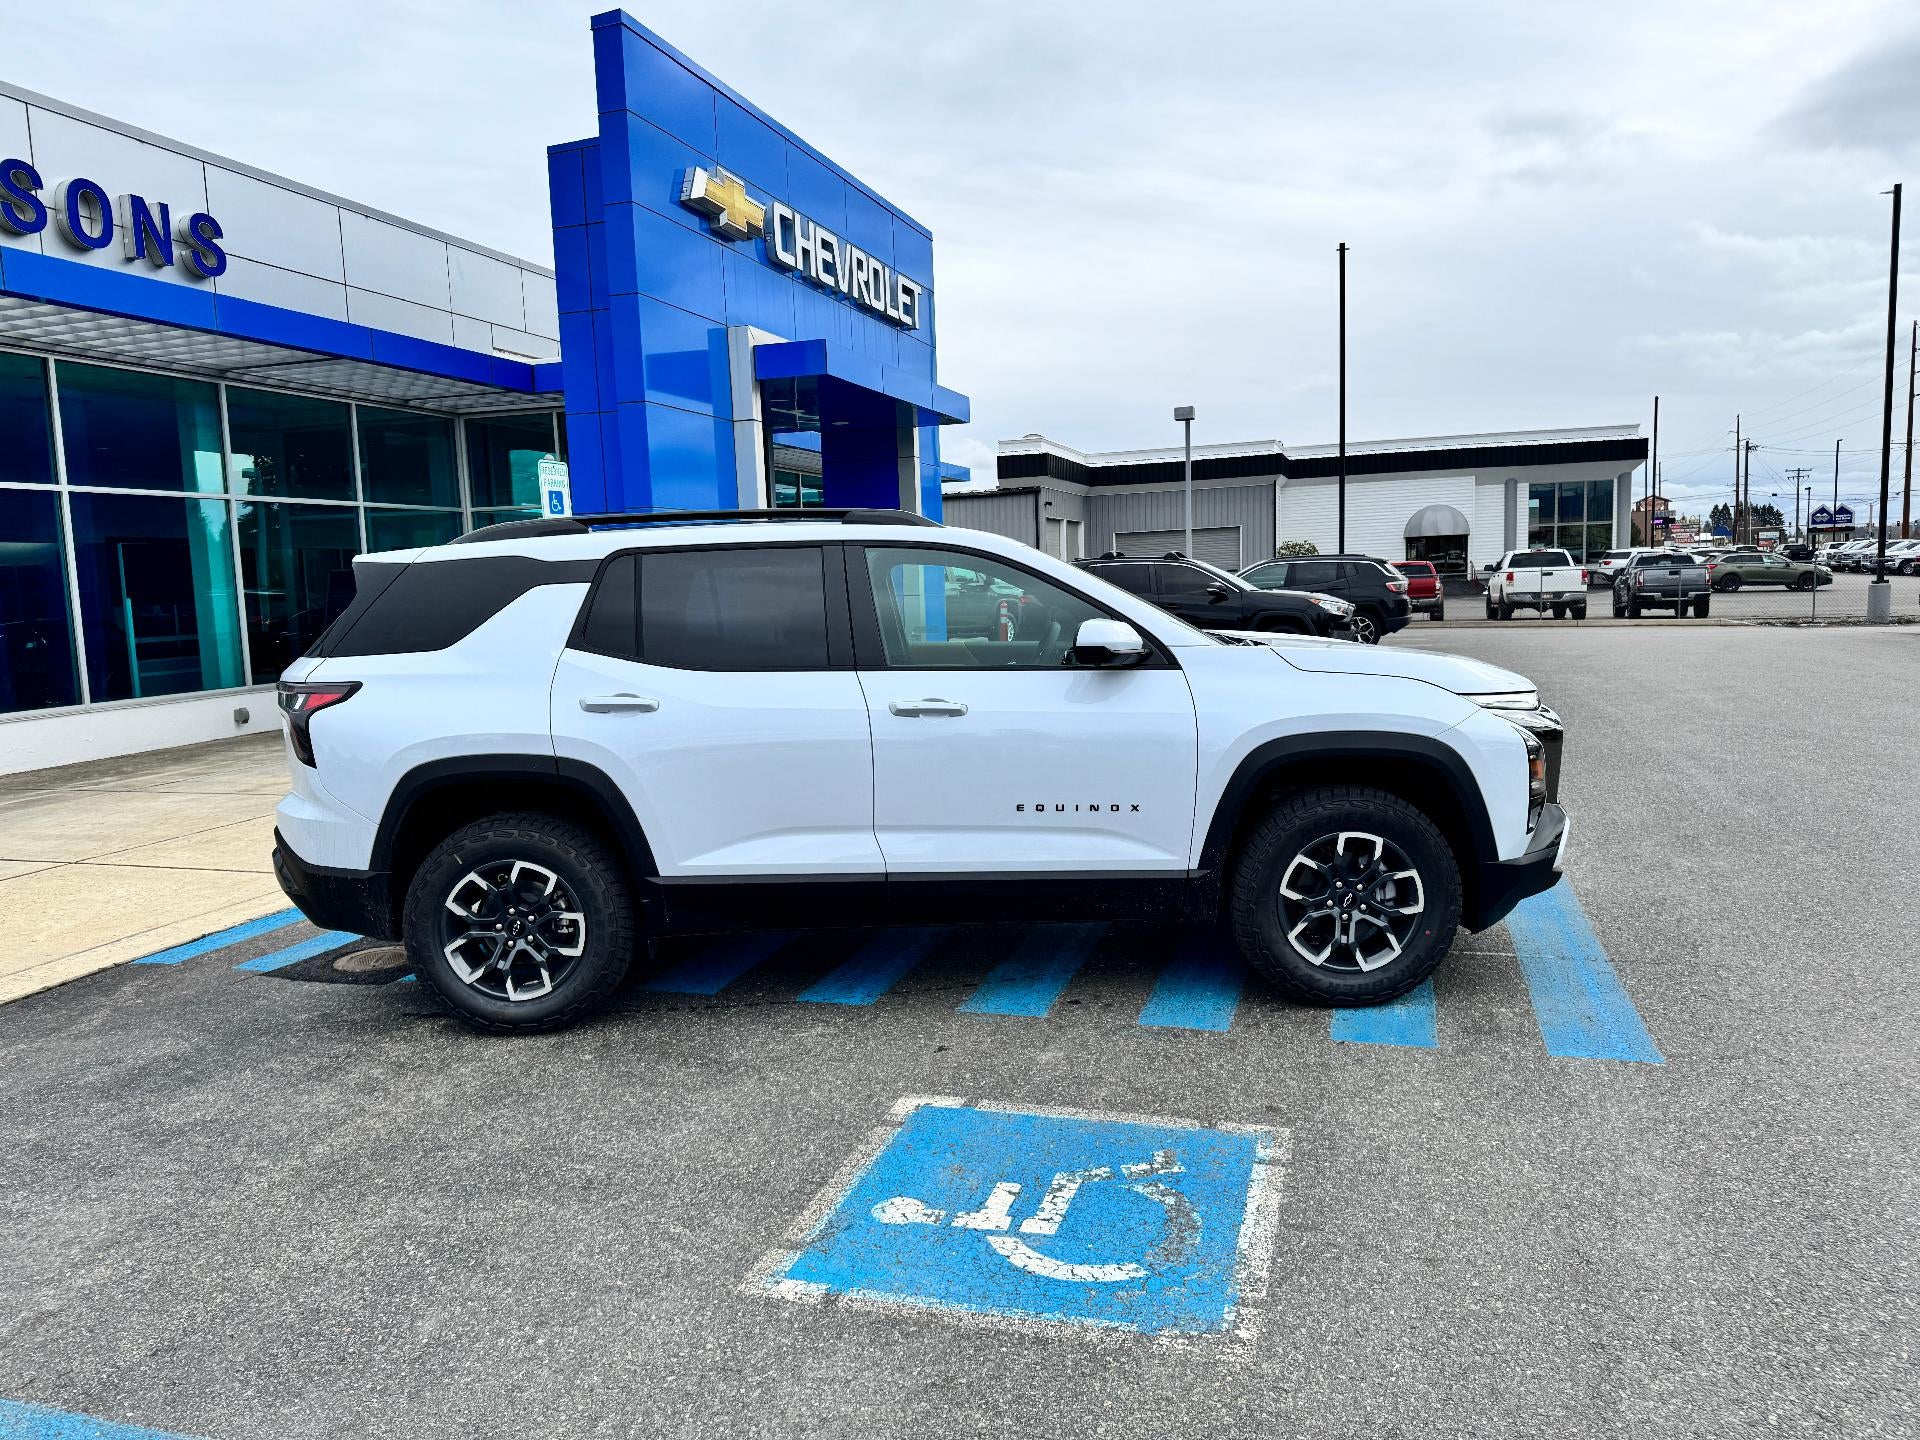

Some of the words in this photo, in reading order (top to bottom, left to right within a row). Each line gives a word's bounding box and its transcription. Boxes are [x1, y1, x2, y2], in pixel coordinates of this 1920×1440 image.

[0, 158, 227, 278] SONS
[768, 201, 922, 330] CHEVROLET
[1016, 803, 1140, 812] EQUINOX
